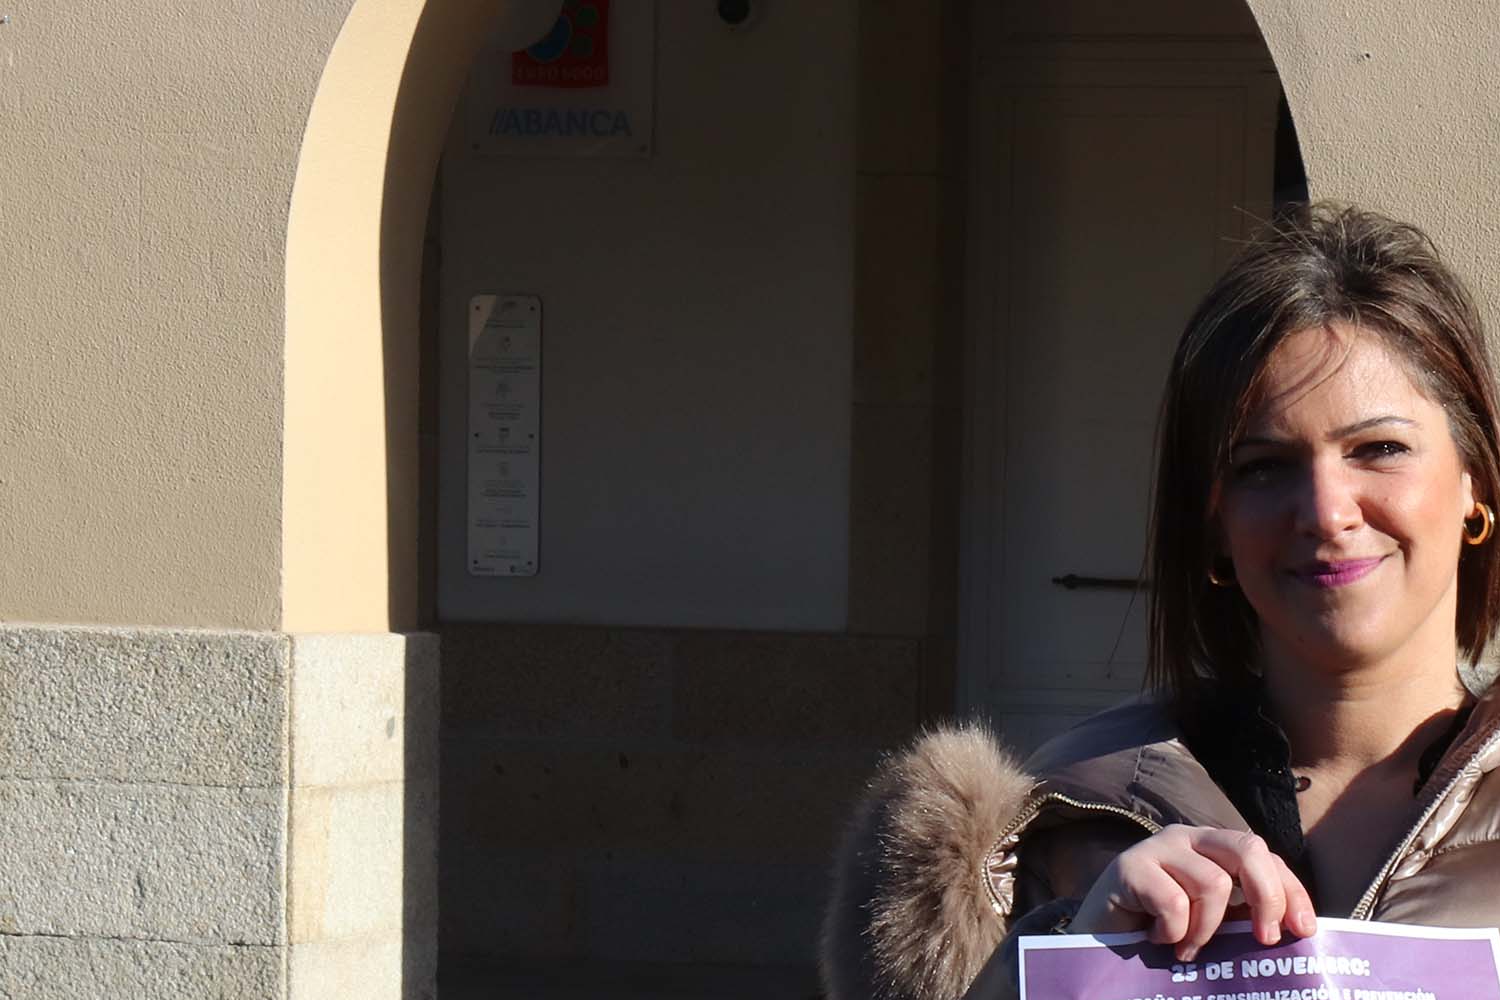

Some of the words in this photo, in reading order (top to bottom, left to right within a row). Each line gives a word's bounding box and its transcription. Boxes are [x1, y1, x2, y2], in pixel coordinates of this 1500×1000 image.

[1171, 964, 1198, 982] 25
[1205, 961, 1234, 980] DE
[1343, 989, 1351, 1000] E
